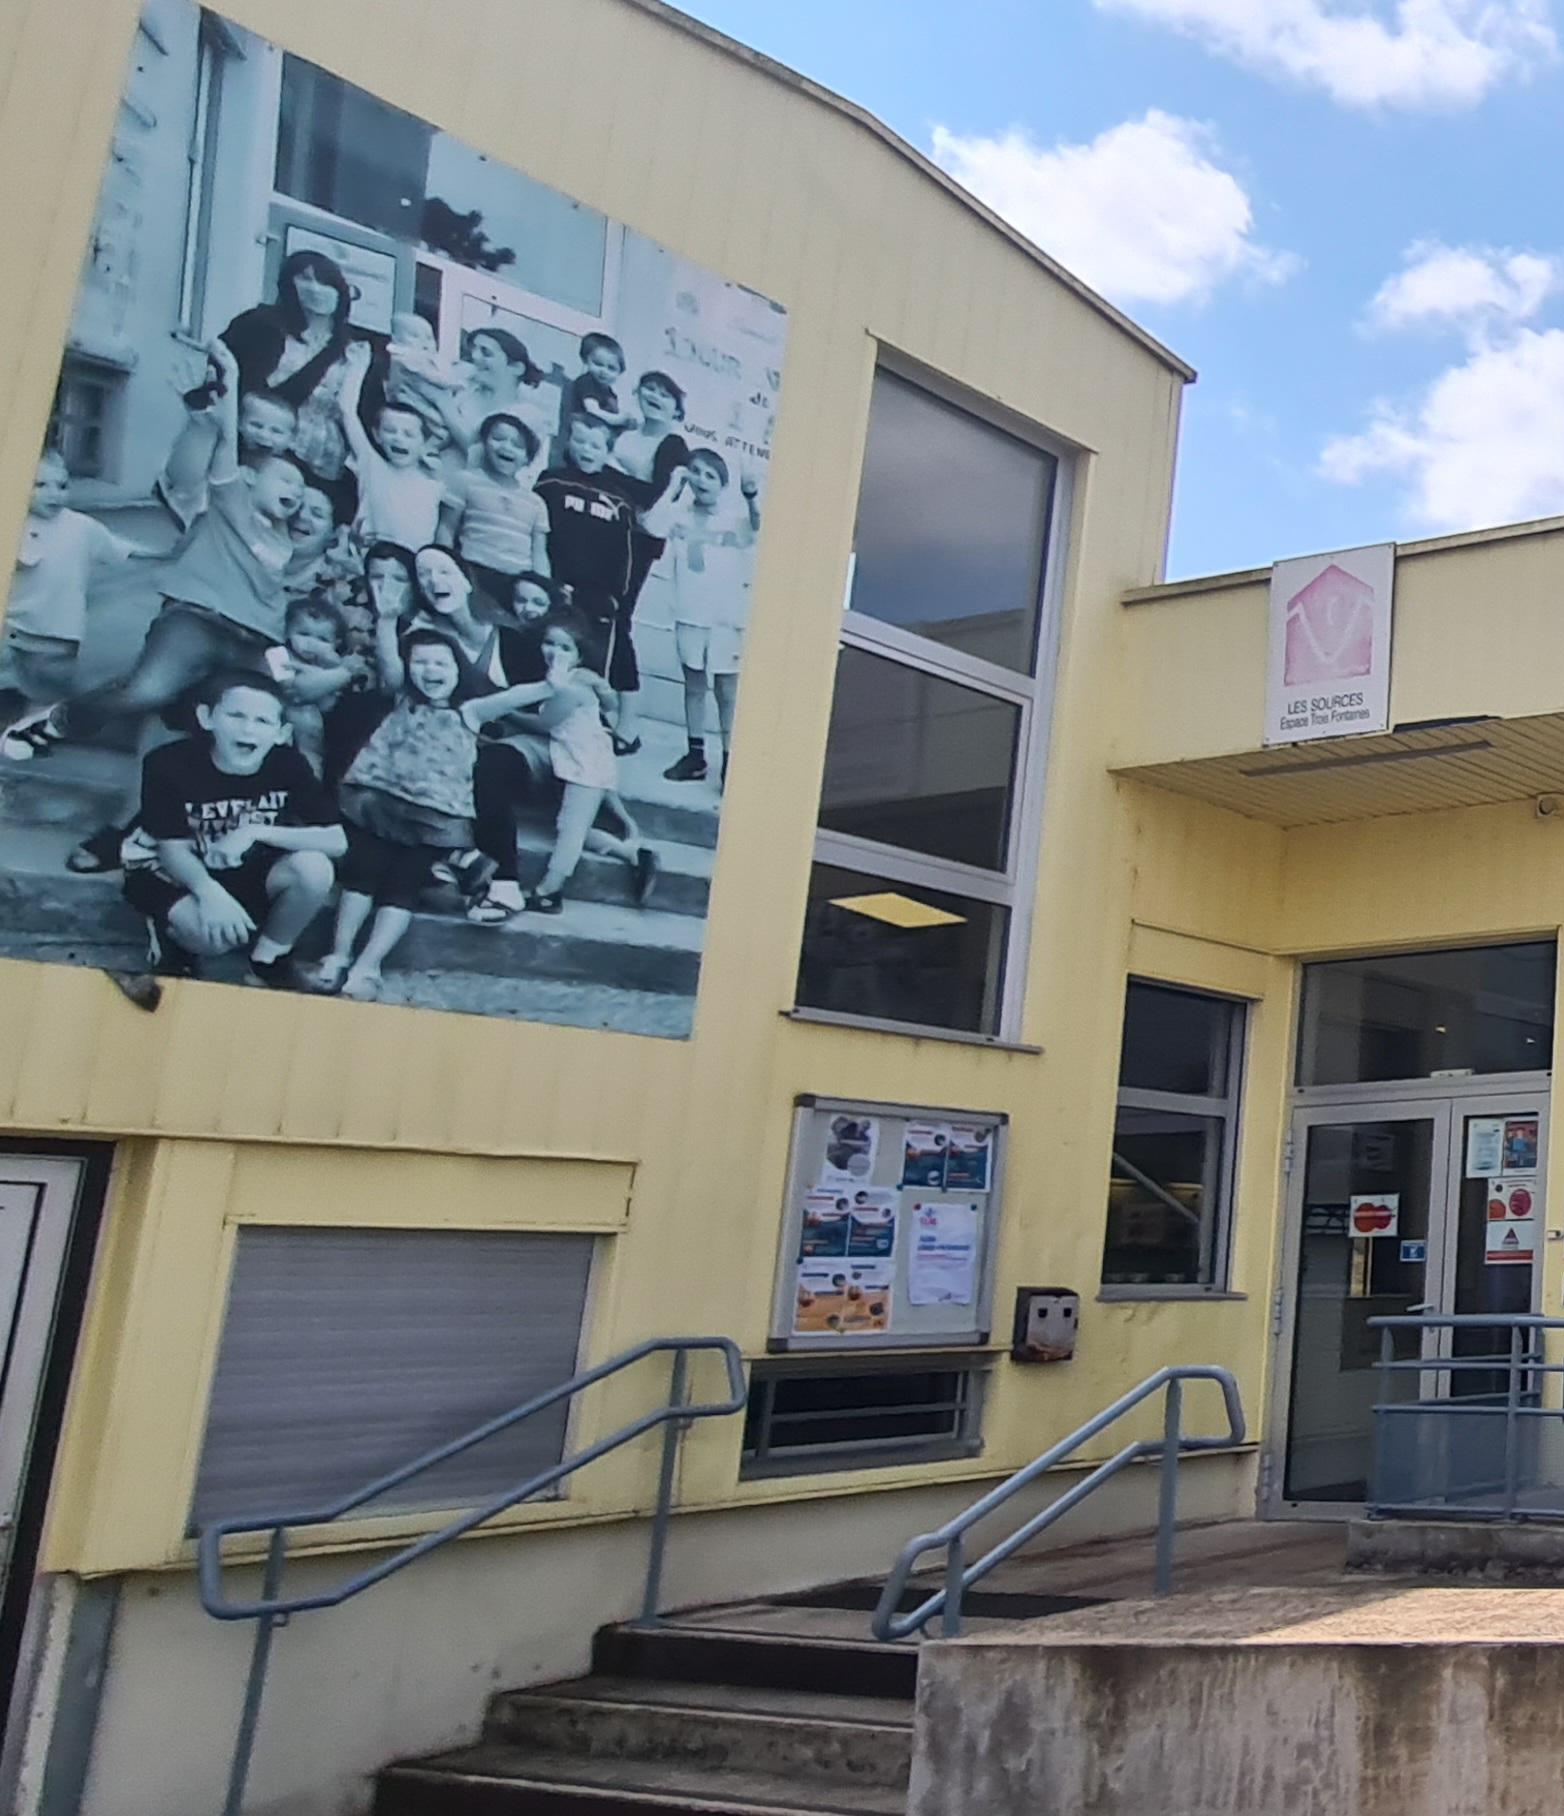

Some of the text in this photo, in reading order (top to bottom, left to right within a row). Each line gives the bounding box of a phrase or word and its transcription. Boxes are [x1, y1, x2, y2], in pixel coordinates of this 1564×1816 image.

[1287, 692, 1364, 715] LES SOURCES
[1280, 716, 1309, 730] Espace
[1331, 708, 1370, 722] Fontaines
